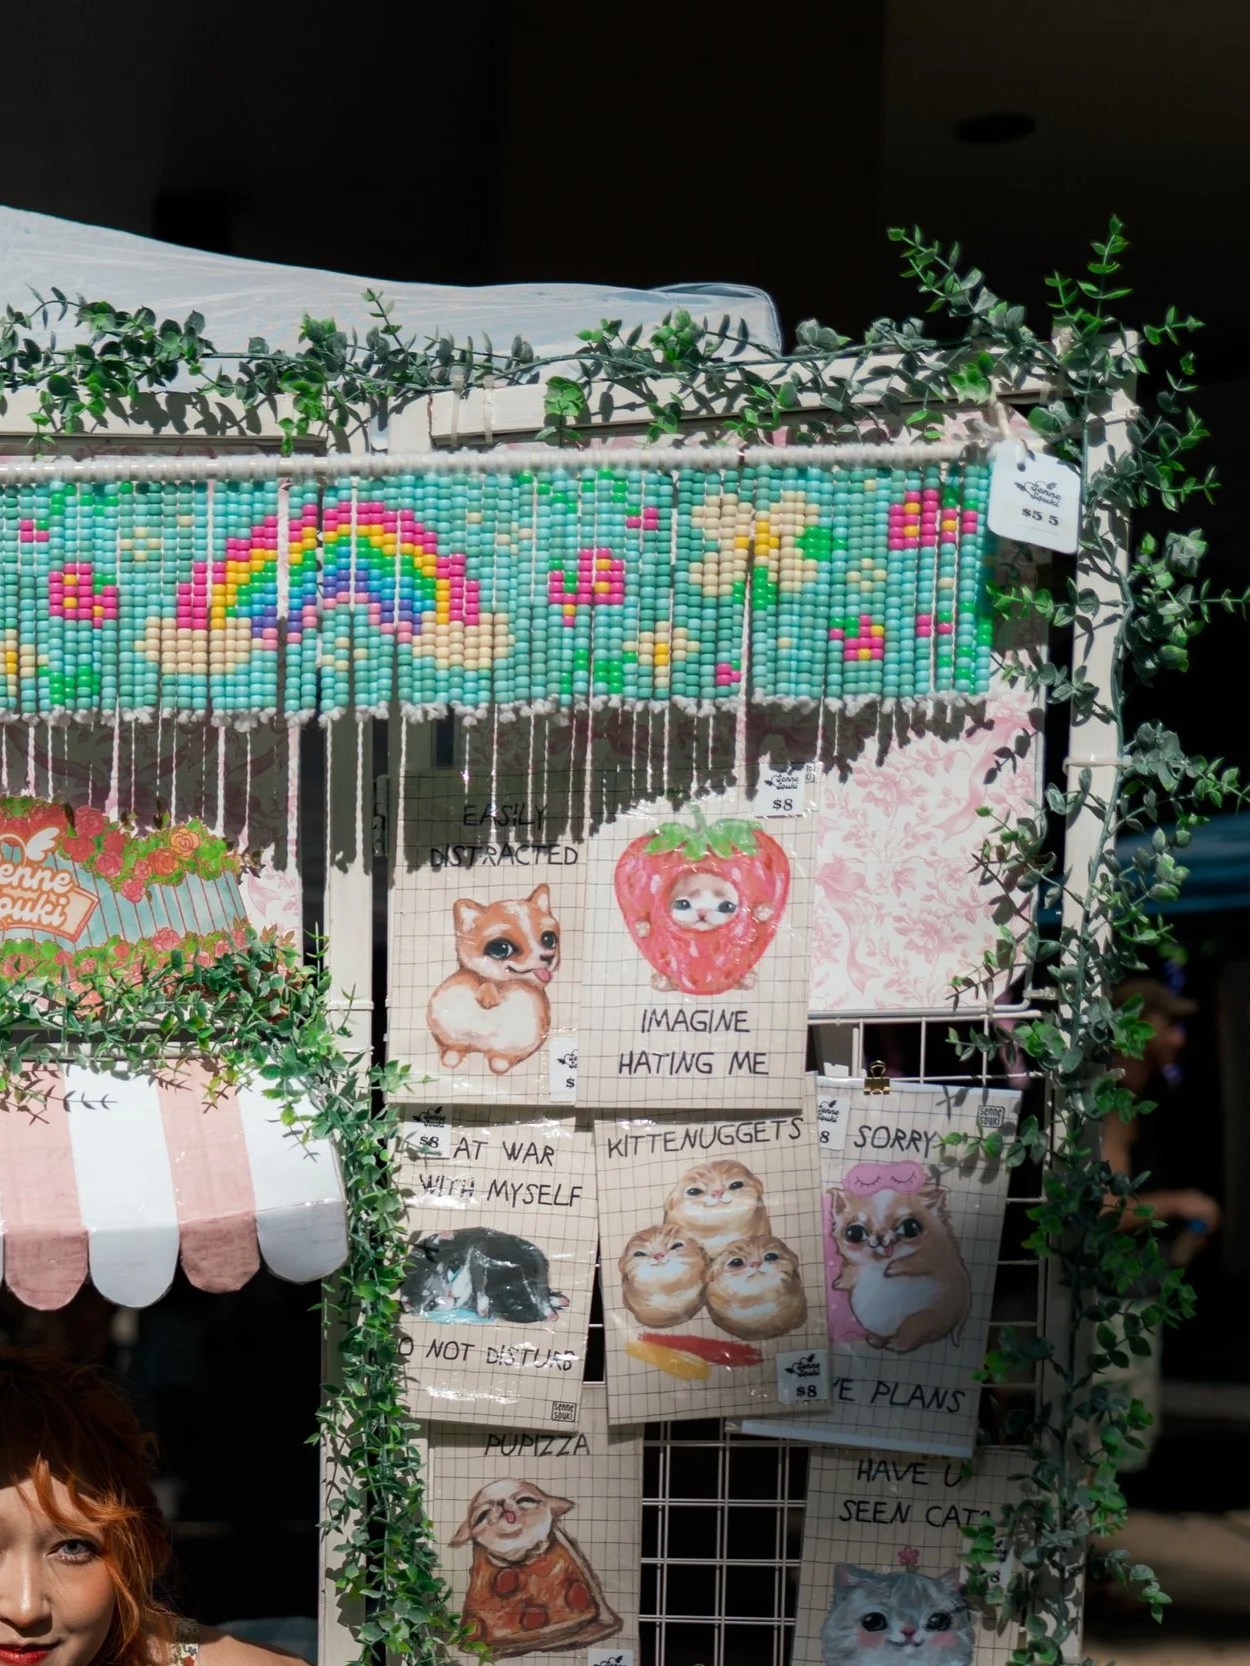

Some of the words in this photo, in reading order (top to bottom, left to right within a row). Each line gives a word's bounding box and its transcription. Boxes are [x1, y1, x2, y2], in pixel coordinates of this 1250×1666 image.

[773, 798, 792, 811] $8
[430, 842, 579, 868] DISTRACTED
[641, 1008, 750, 1034] IMAGINE
[619, 1052, 713, 1075] HATING
[729, 1052, 769, 1075] ME
[420, 1136, 439, 1148] $8
[607, 1116, 805, 1159] KITTENUGGETS
[854, 1124, 938, 1159] SORRY
[453, 1139, 487, 1161] AT
[504, 1142, 555, 1168] WAR
[487, 1181, 583, 1208] MYSELF
[426, 1338, 475, 1363] NOT
[796, 1385, 817, 1398] $8
[870, 1380, 966, 1413] PLANS
[485, 1433, 591, 1457] PUPIZZA
[857, 1458, 928, 1486] HAVE
[944, 1464, 963, 1487] U
[839, 1500, 911, 1524] SEEN
